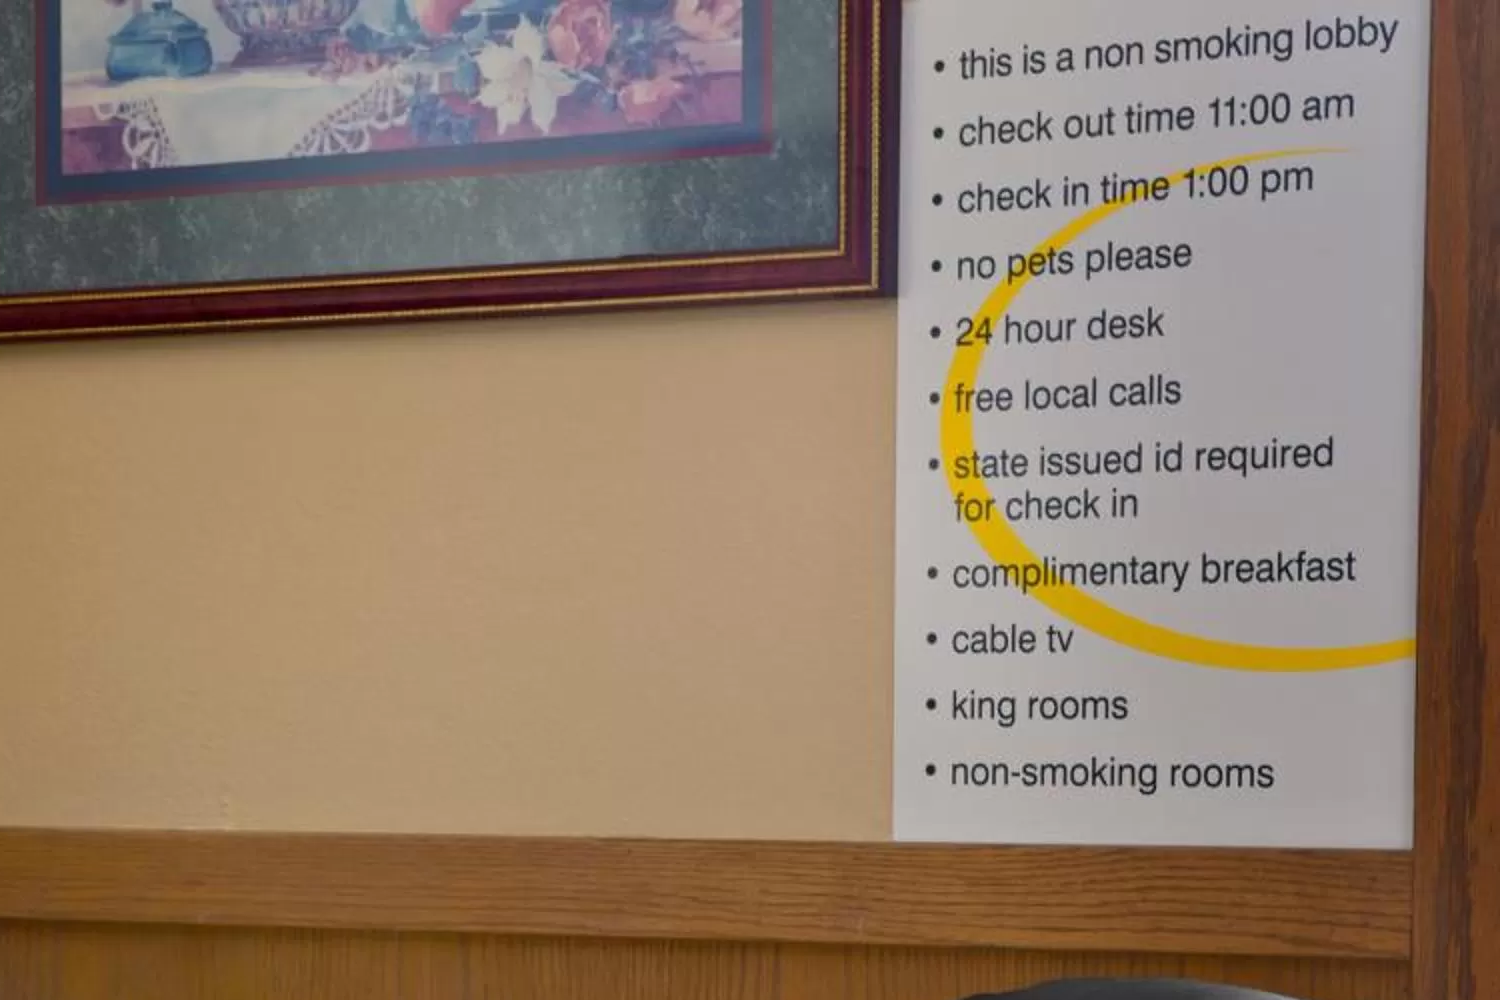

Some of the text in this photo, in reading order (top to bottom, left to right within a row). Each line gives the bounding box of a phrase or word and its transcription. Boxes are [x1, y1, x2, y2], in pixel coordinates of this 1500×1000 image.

[959, 16, 1399, 80] this is a non smoking lobby
[959, 92, 1354, 147] check out time 11:00 am
[958, 164, 1313, 214] check in time 1:00 pm
[957, 240, 1192, 285] no pets please
[956, 306, 1165, 347] 24 hour desk
[954, 374, 1182, 413] free local calls
[954, 436, 1333, 479] state issued id required
[954, 487, 1138, 523] for check in
[953, 550, 1356, 595] complimentary breakfast
[951, 623, 1074, 654] cable tv
[952, 689, 1129, 728] king rooms
[951, 756, 1275, 796] non-smoking rooms
